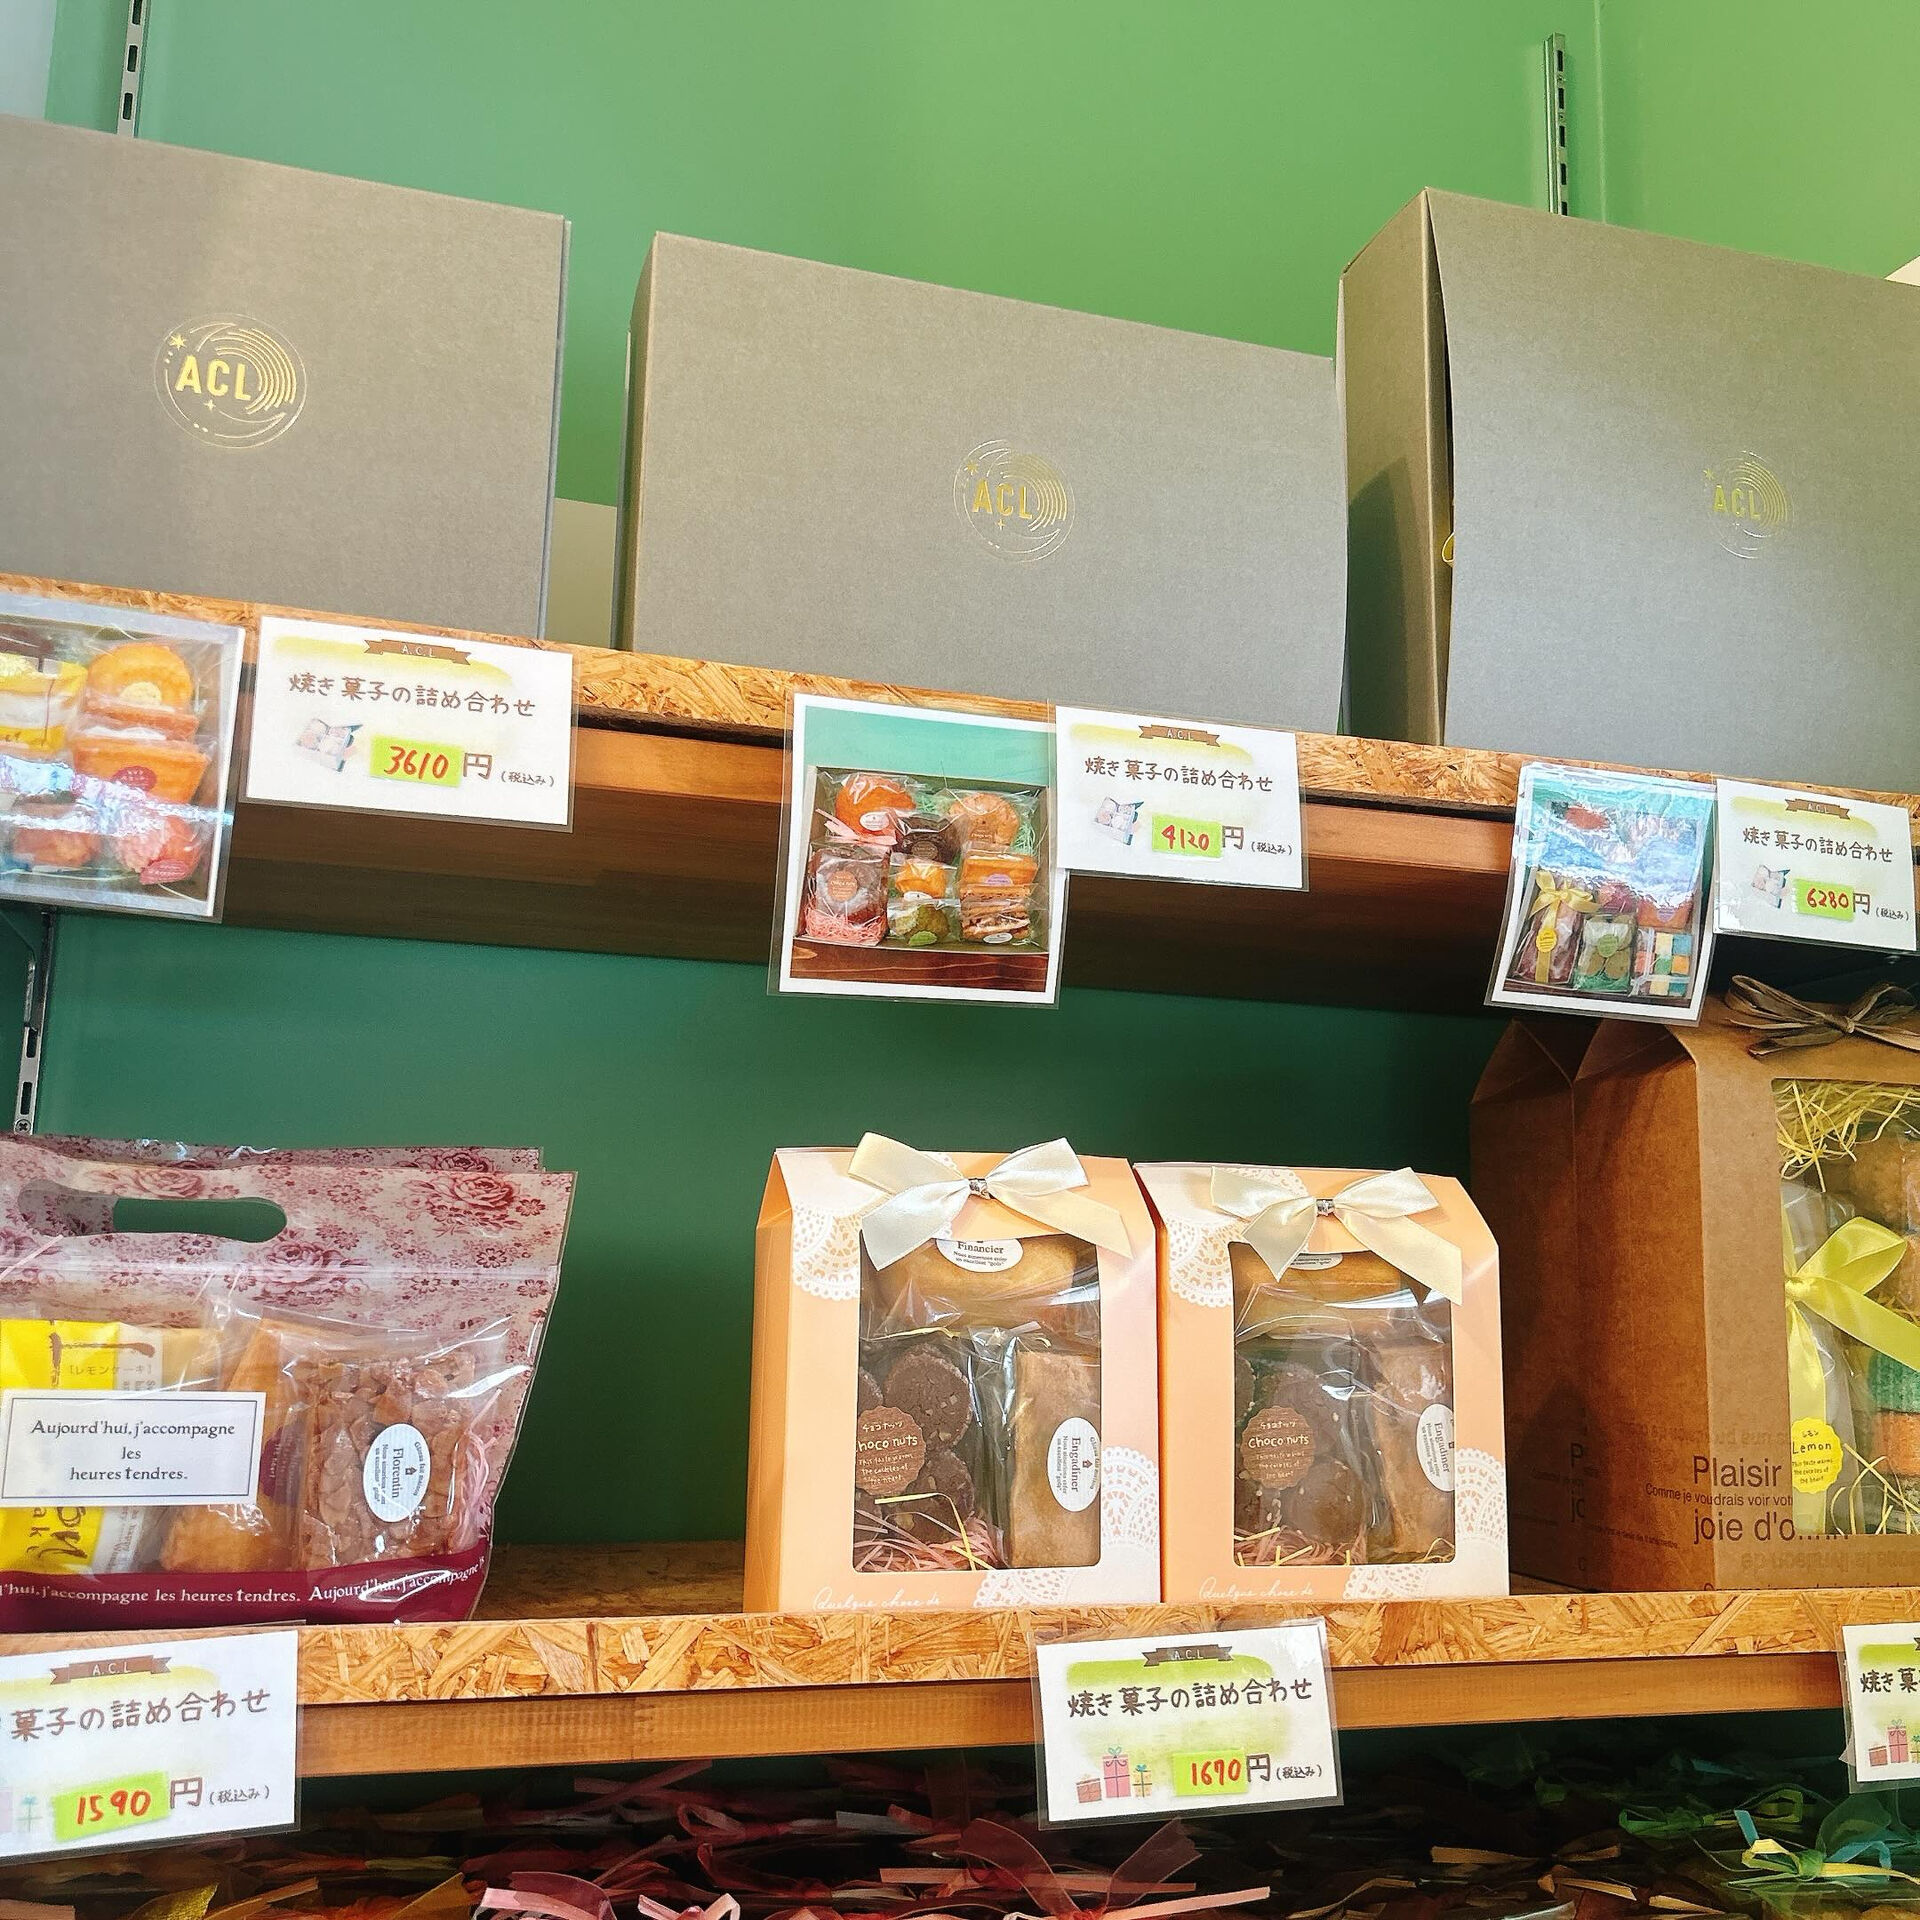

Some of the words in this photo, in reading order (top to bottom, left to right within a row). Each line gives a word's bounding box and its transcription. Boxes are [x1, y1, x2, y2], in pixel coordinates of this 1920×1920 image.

[175, 355, 251, 401] ACL
[972, 478, 1033, 520] ACL
[1713, 484, 1760, 520] ACL
[957, 1241, 1004, 1254] Financier
[121, 1446, 141, 1460] les
[856, 1440, 889, 1452] hoco
[892, 1434, 918, 1447] nuts
[1286, 1434, 1310, 1445] nuts
[1434, 1422, 1450, 1472] Engadiner
[1792, 1441, 1831, 1454] Lemon
[70, 1467, 121, 1481] heures
[125, 1466, 188, 1481] tendres.
[392, 1448, 404, 1498] Florentin
[1069, 1437, 1081, 1492] Engadiner
[1693, 1455, 1782, 1487] Plaisir
[1645, 1483, 1681, 1500] Comme
[1682, 1490, 1692, 1504] je
[1694, 1493, 1744, 1506] voudrais
[1748, 1494, 1770, 1506] voir
[1693, 1508, 1743, 1544] joie
[156, 1588, 176, 1601] les
[182, 1588, 233, 1602] heures
[236, 1588, 300, 1602] tendres.
[1860, 1667, 1920, 1694] 焼き菓
[0, 1688, 270, 1741] 菓子の詰め合わせ
